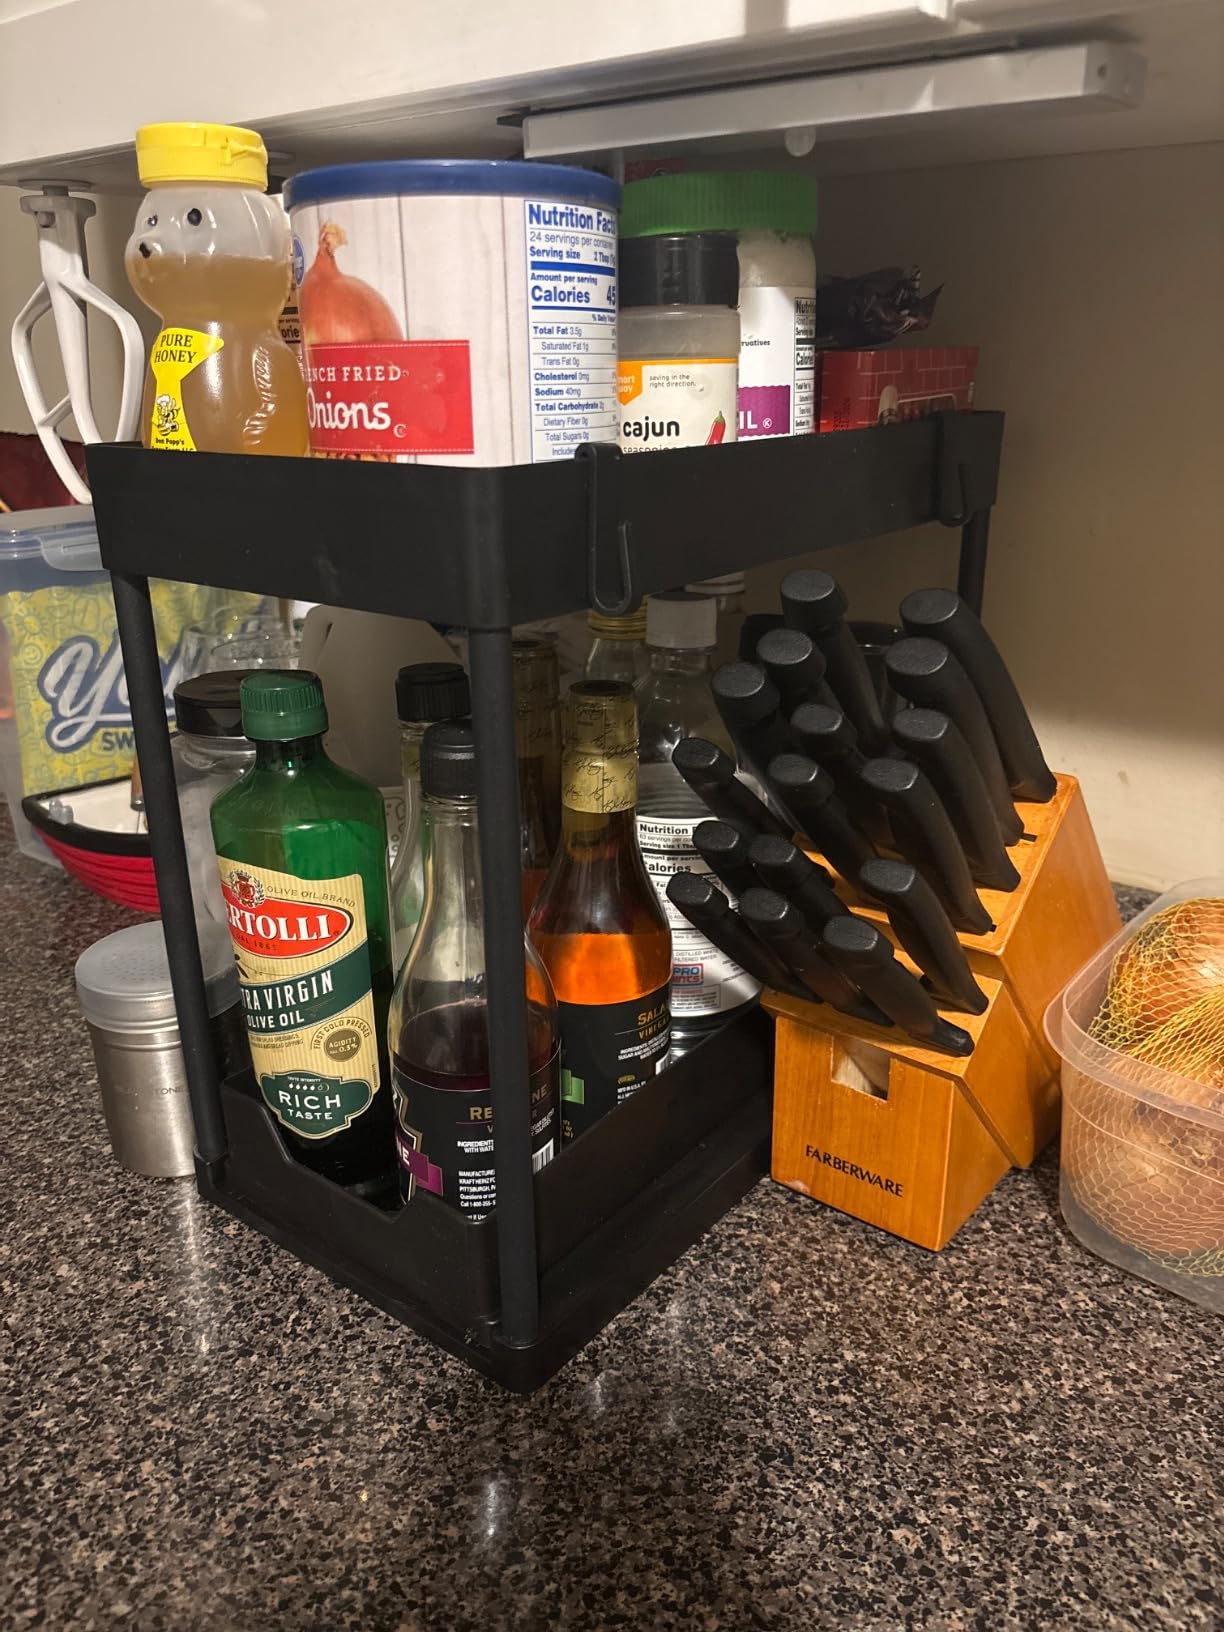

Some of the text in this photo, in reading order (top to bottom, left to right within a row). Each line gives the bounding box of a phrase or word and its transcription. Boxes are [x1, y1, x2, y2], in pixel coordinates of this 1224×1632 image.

[528, 203, 593, 230] Nutrition
[529, 231, 542, 243] 24
[544, 233, 580, 247] servings
[529, 246, 564, 261] Serving
[565, 248, 581, 260] size
[531, 272, 598, 286] Amount per serving
[531, 285, 616, 306] Calories 45
[533, 326, 583, 338] Total Fat 3.5g
[154, 334, 197, 363] PURE HONEY
[541, 341, 572, 351] Saturated
[541, 357, 561, 367] Trans
[342, 365, 401, 382] FRIED
[534, 371, 578, 382] Cholesterol
[649, 375, 670, 383] saving
[649, 380, 697, 390] right direction.
[535, 387, 564, 397] Sodium
[306, 386, 392, 431] Onions
[535, 402, 556, 412] Total
[557, 401, 598, 412] Carbohydrate
[544, 417, 566, 428] Dietary
[567, 416, 581, 426] Fiber
[623, 415, 680, 442] cajun
[545, 431, 561, 442] Total
[562, 431, 582, 443] Sugars
[639, 823, 689, 835] Nutrition
[639, 841, 661, 849] Serving
[645, 862, 692, 873] alories
[266, 885, 356, 909] OLIVE OIL BRAND
[672, 966, 700, 975] PRO
[263, 969, 334, 1011] VIRGIN
[247, 1010, 305, 1029] OLIVE OIL
[313, 1019, 370, 1049] FIRST COLD PRESSED
[329, 1037, 356, 1048] ACIDITY
[278, 1089, 342, 1110] RICH
[287, 1108, 333, 1120] TASTE
[805, 1143, 904, 1198] FARBERWARE
